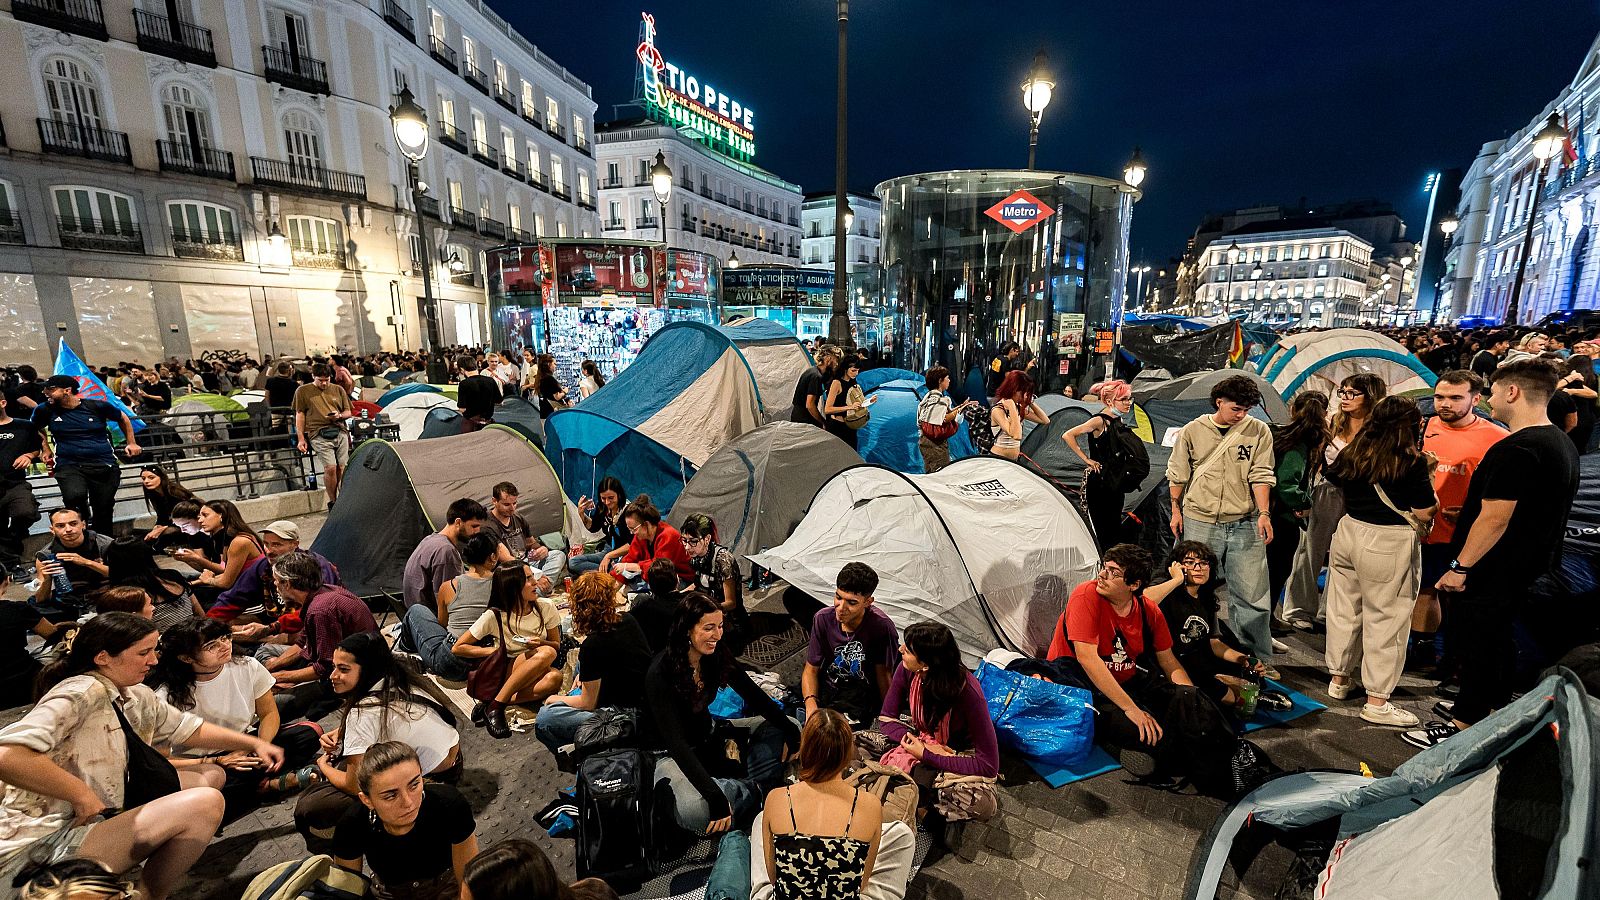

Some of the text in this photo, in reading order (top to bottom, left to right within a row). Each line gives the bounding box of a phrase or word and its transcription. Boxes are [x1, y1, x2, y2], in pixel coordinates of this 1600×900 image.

[666, 62, 754, 131] TIO PEPE
[1004, 206, 1036, 217] Metro
[738, 274, 762, 283] TOURS
[767, 274, 795, 283] TICKETS
[812, 293, 821, 302] EL
